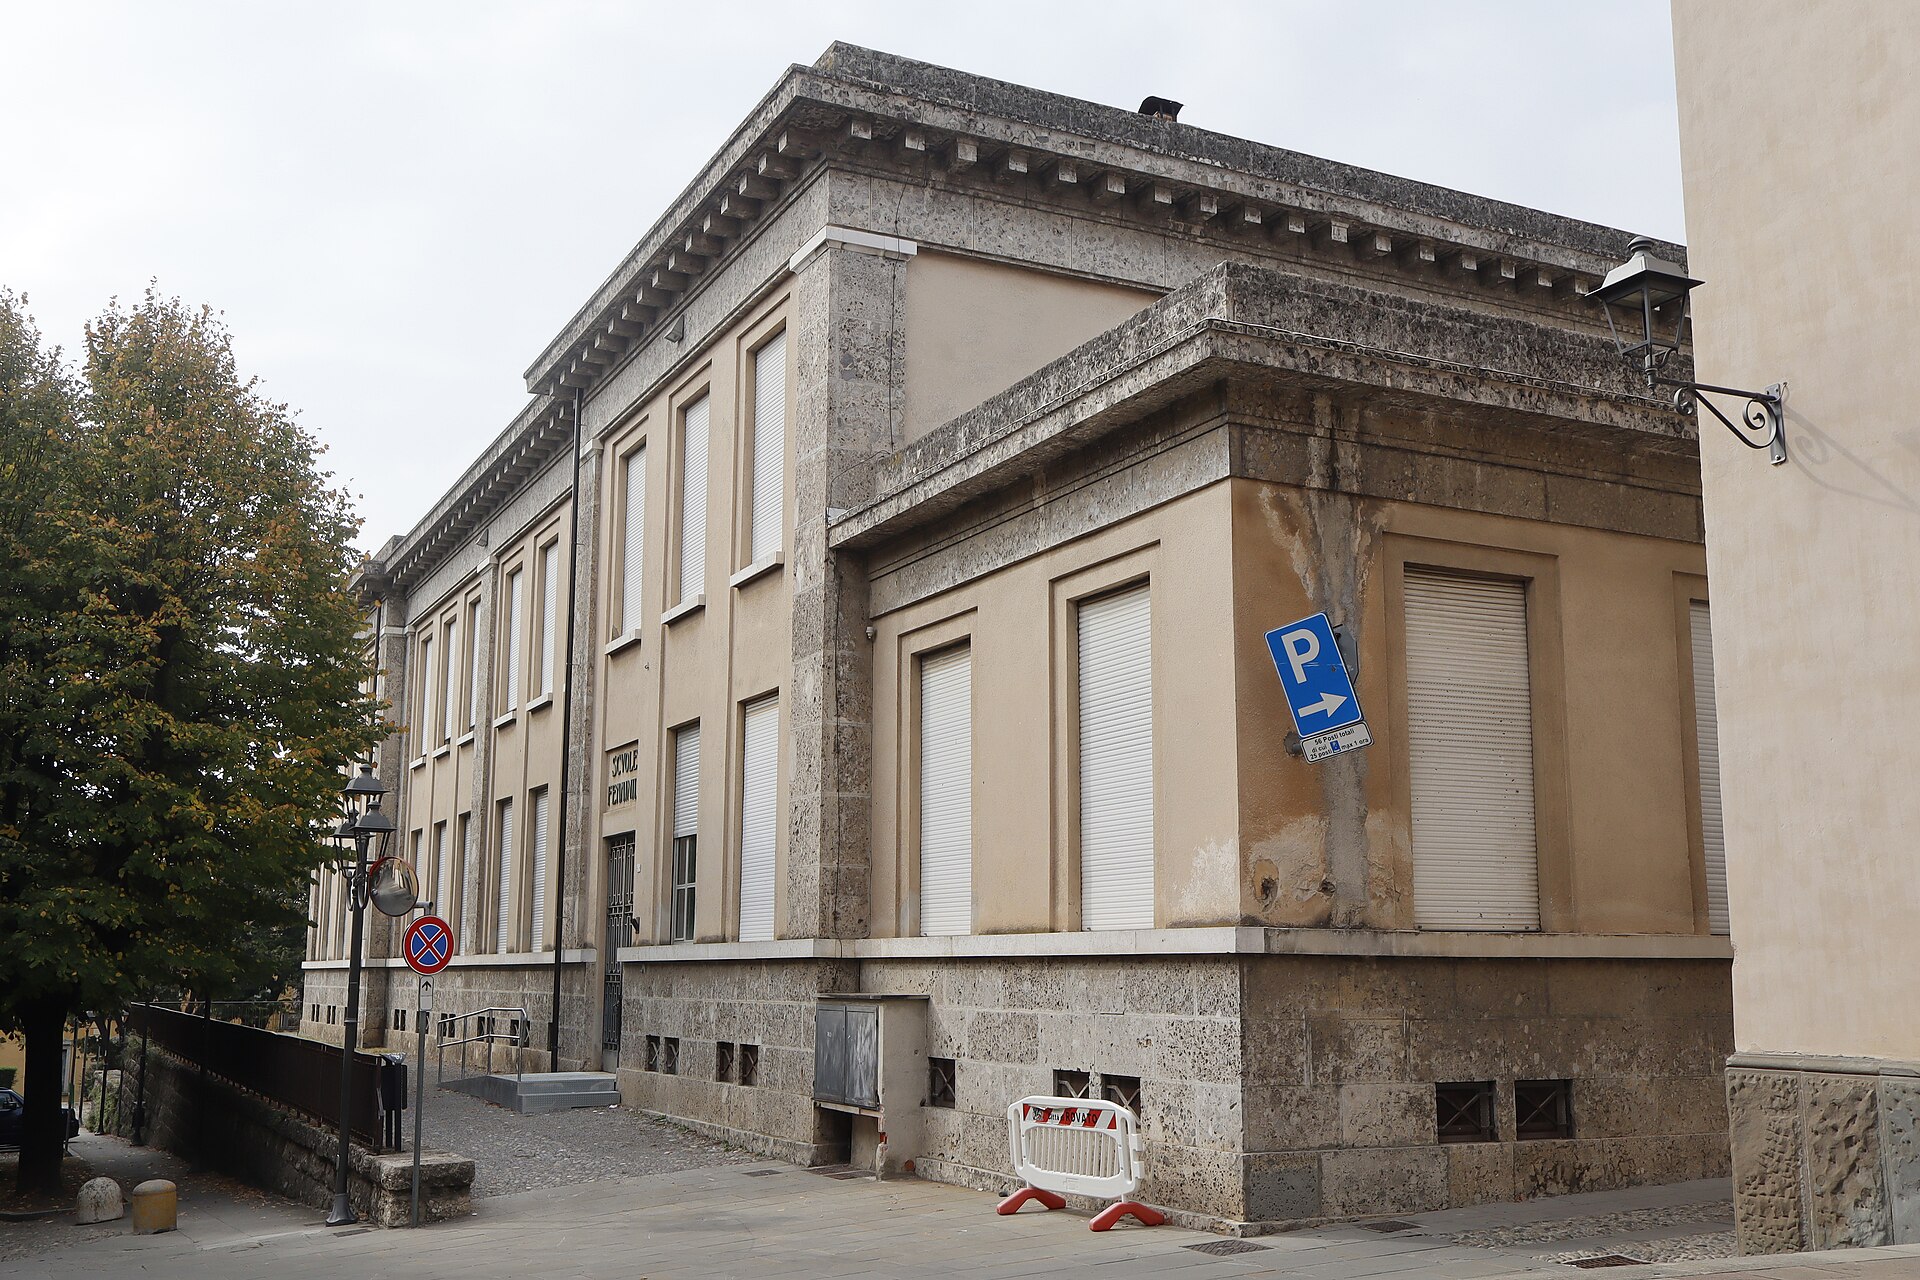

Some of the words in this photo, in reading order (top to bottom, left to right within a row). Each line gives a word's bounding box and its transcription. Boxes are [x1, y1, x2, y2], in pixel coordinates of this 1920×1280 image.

[1281, 629, 1320, 684] P
[1314, 737, 1323, 745] 56
[1323, 733, 1338, 743] Posti
[1339, 728, 1355, 738] totali
[1318, 744, 1327, 752] cui
[1318, 749, 1332, 758] posti
[1065, 1111, 1097, 1123] ROVATO
